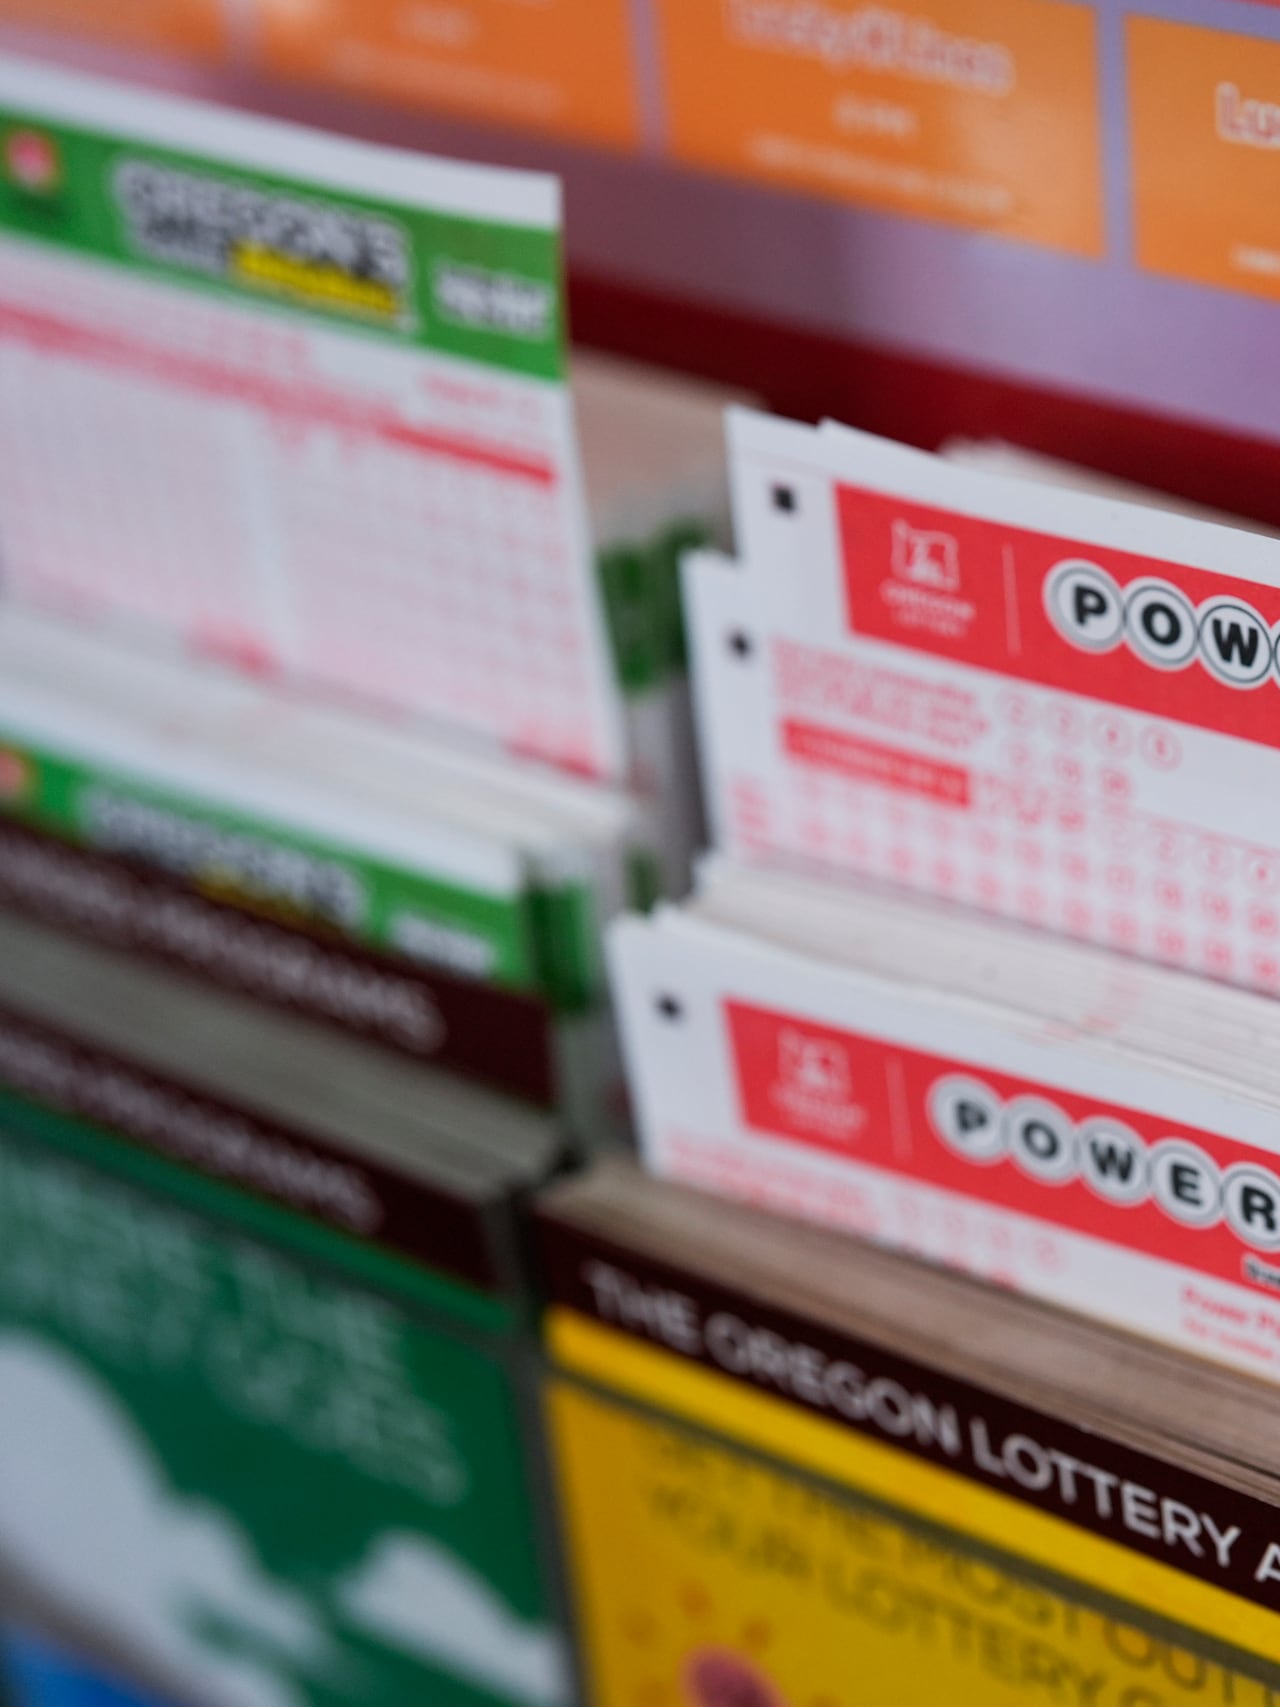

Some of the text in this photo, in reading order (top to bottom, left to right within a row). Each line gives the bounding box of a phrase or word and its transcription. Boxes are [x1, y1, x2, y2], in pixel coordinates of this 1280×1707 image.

[588, 1261, 698, 1352] THE
[705, 1312, 961, 1455] OREGON
[969, 1417, 1242, 1567] LOTTERY
